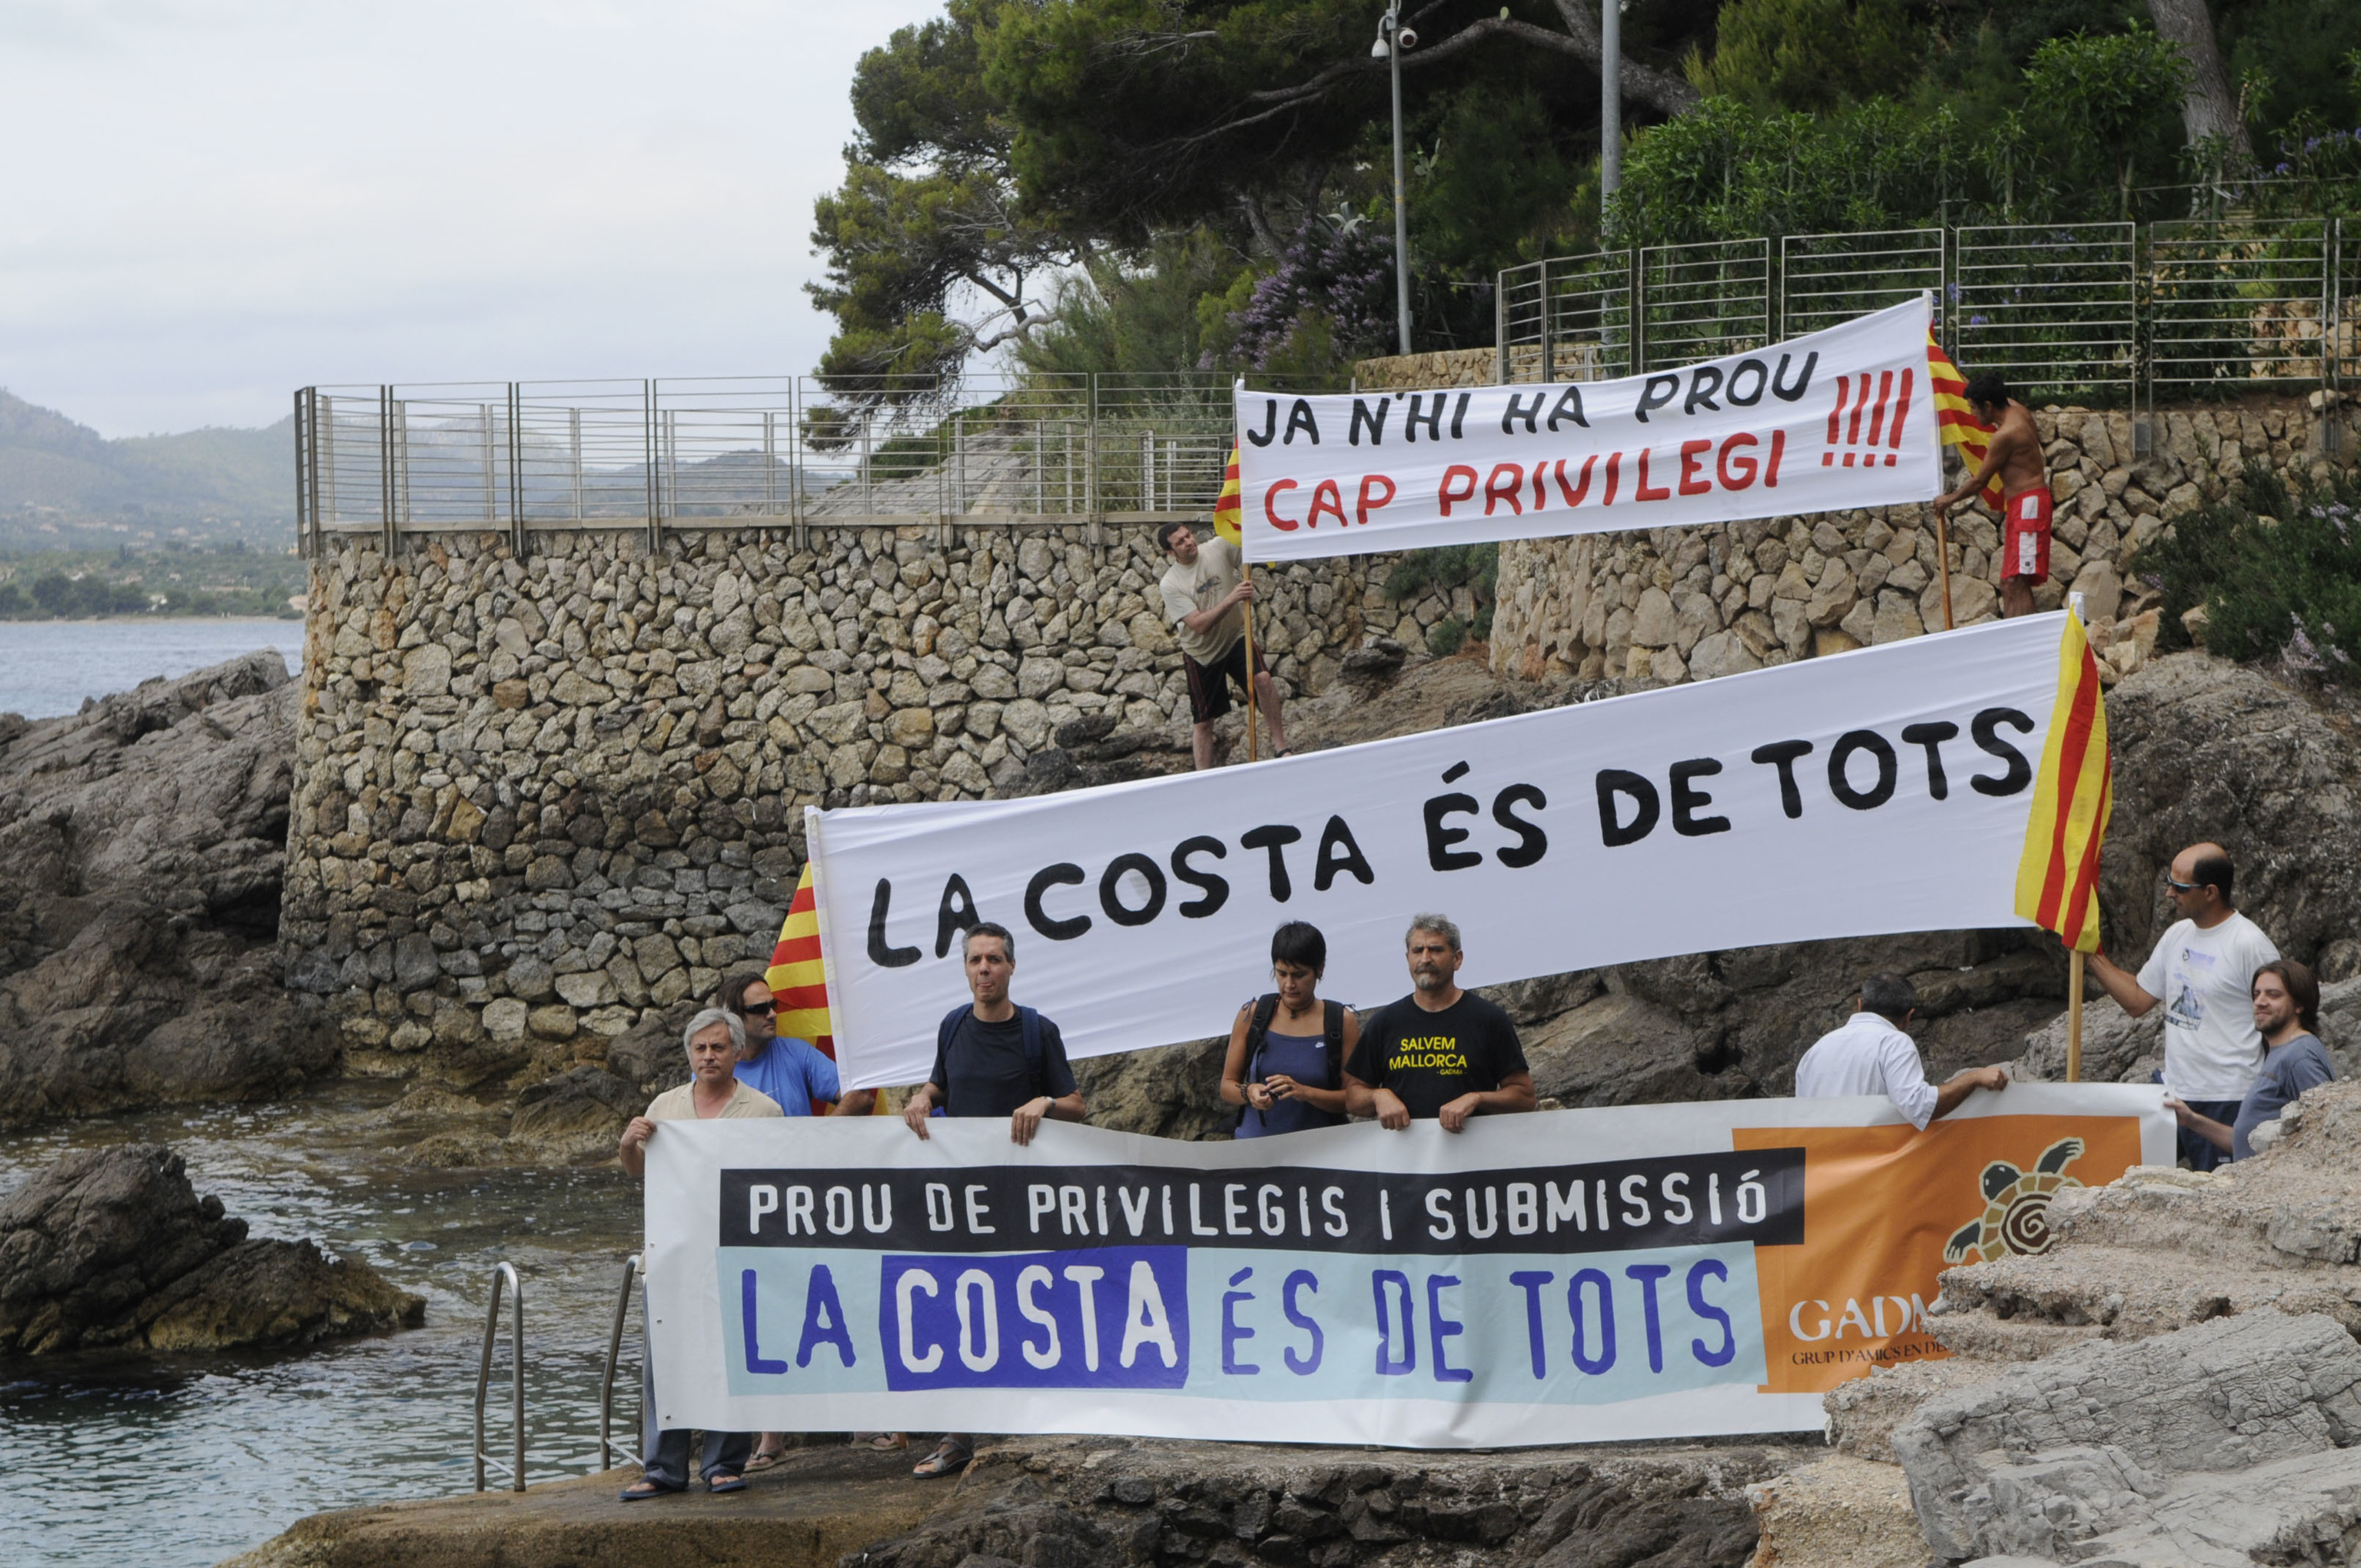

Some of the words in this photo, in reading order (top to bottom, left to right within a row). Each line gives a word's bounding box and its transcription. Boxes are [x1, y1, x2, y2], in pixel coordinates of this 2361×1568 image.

[1247, 397, 1320, 447] JA
[1348, 391, 1470, 446] N'HI
[1503, 384, 1589, 435] HA
[1635, 351, 1818, 424] PROU
[1265, 474, 1396, 531] CAP
[1438, 430, 1785, 517] PRIVILEGI
[867, 873, 982, 968] LA
[1024, 815, 1375, 941] COSTA
[1423, 760, 1548, 872] ÉS
[1596, 757, 1732, 848] DE
[1751, 707, 2035, 819] TOTS
[1389, 1053, 1468, 1071] MALLORCA
[1400, 1036, 1456, 1052] SALVEM
[749, 1184, 892, 1235] PROU
[925, 1182, 996, 1234] DE
[1028, 1183, 1349, 1237] PRIVILEGIS
[1380, 1189, 1393, 1241] I
[1423, 1169, 1767, 1240] SUBMISSIÓ
[742, 1264, 857, 1375] LA
[895, 1261, 1179, 1374] COSTA
[1221, 1266, 1323, 1376] ÉS
[1371, 1269, 1474, 1383] DE
[1509, 1258, 1736, 1380] TOTS
[1792, 1350, 1835, 1366] GRUP
[1904, 1344, 1922, 1357] EN
